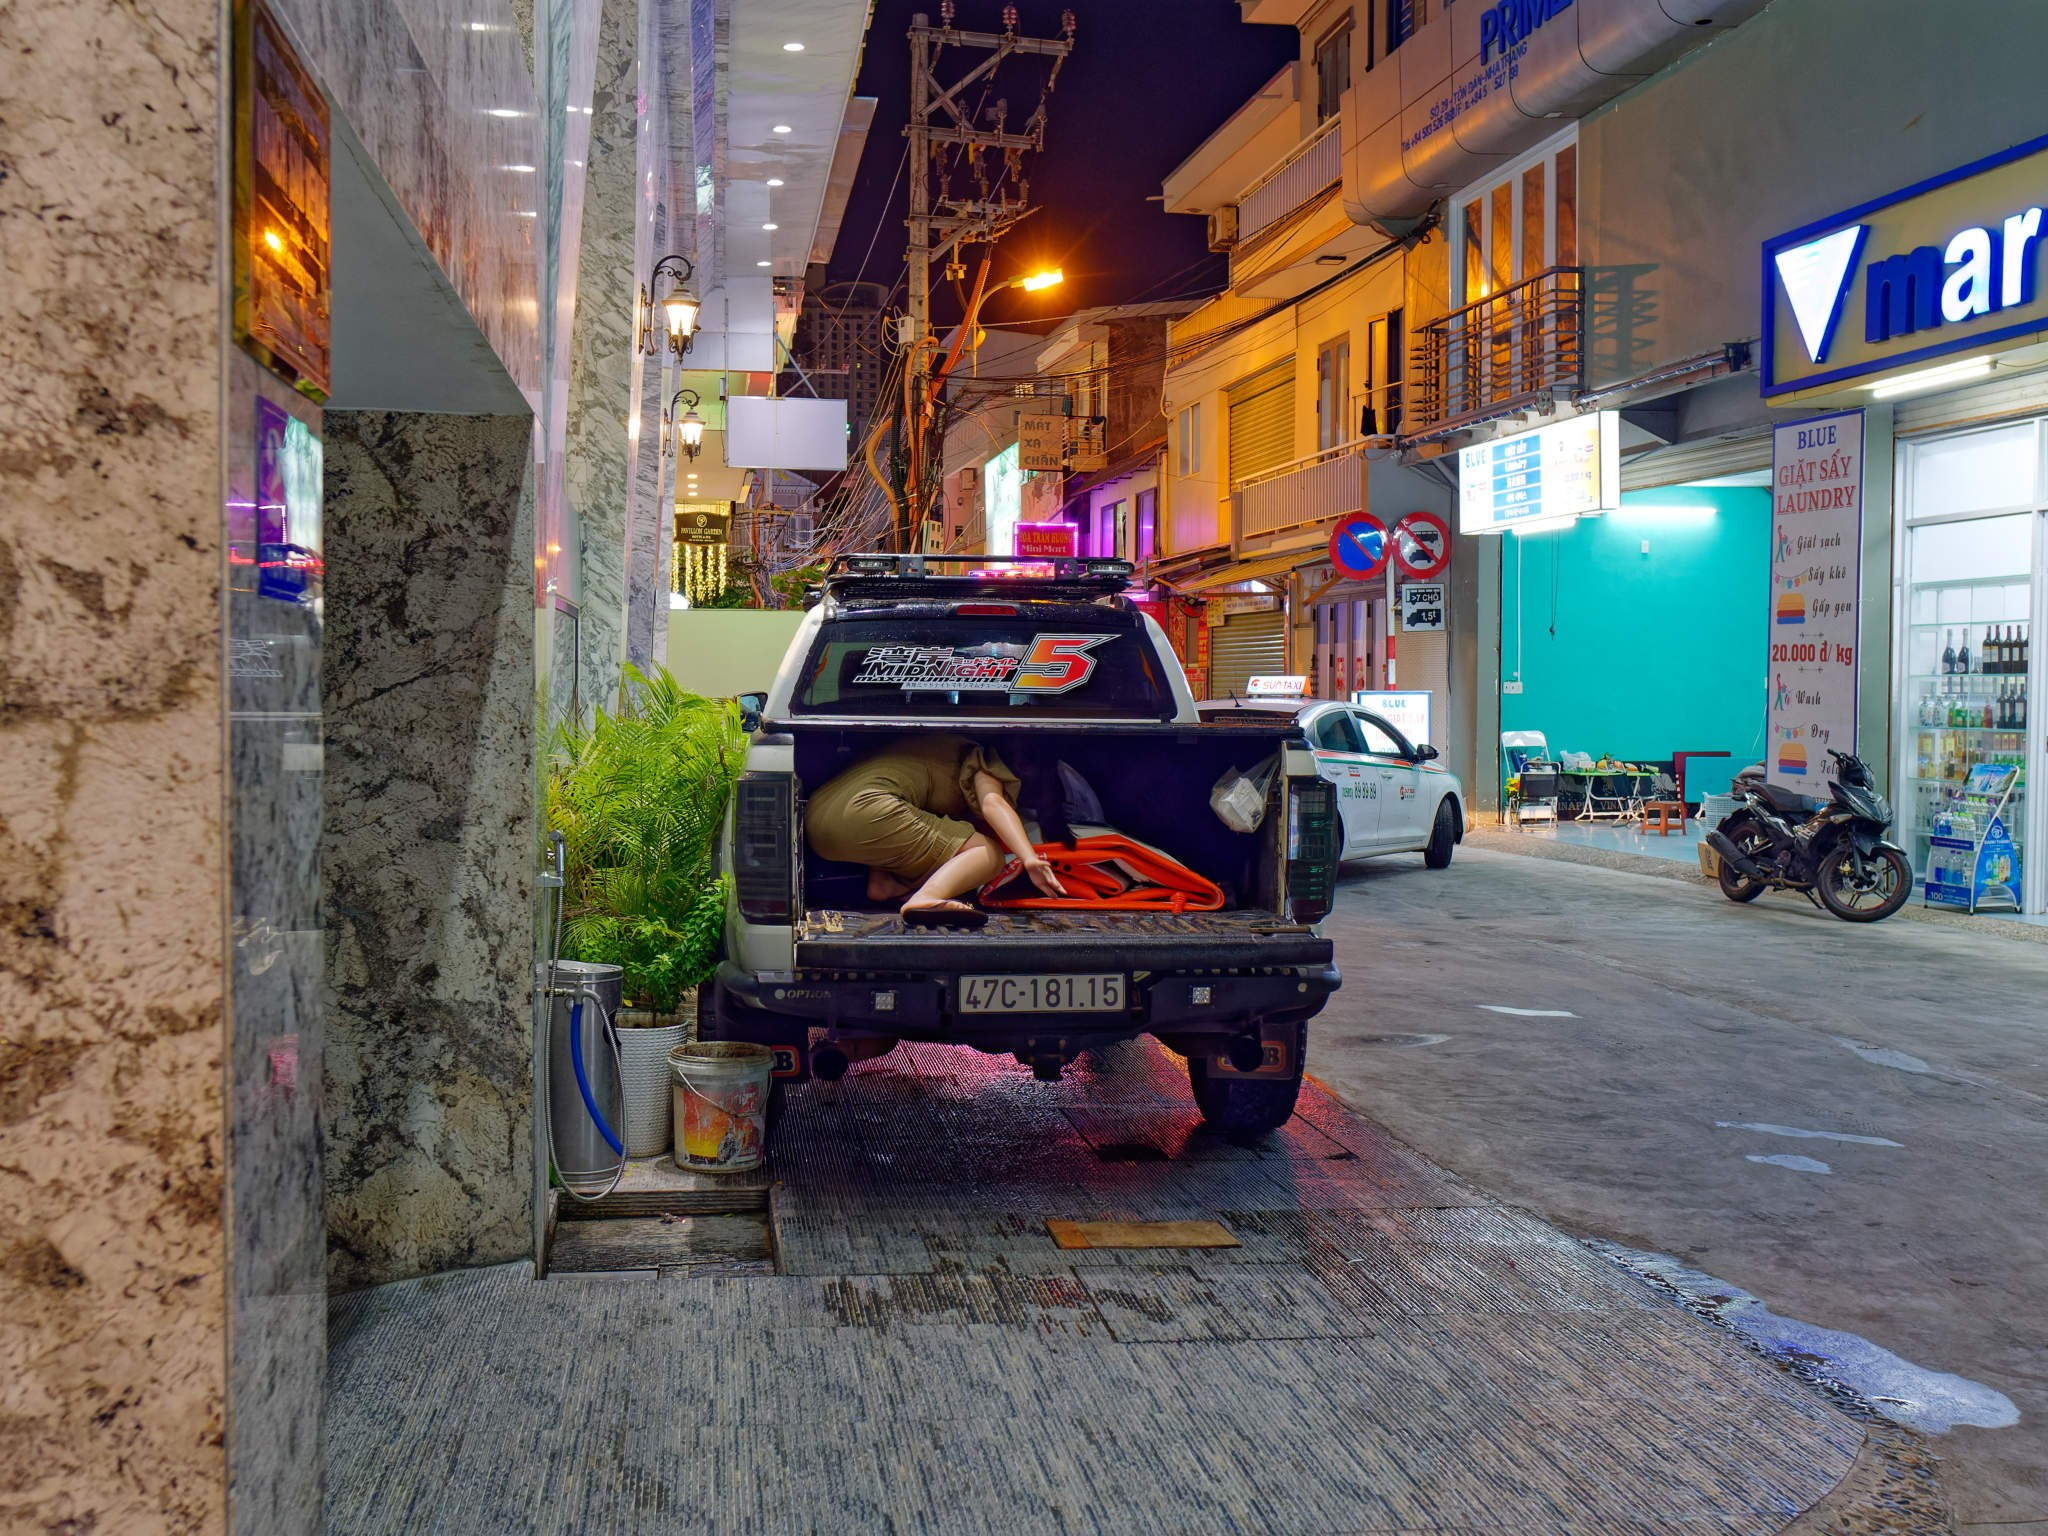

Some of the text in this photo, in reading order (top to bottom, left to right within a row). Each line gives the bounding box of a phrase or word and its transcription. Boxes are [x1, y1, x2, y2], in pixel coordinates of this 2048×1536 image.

[1797, 425, 1837, 450] BLUE
[1778, 448, 1852, 487] GIẶT SẤY
[1776, 485, 1857, 515] LAUNDRY
[1021, 544, 1067, 553] Mini Mart
[1772, 644, 1815, 662] 20.000
[1836, 643, 1853, 666] kg
[865, 657, 1020, 678] MIDNIGHT
[1283, 680, 1302, 690] TAXI
[1382, 699, 1407, 708] BLUE
[1795, 690, 1821, 705] Wash
[1810, 723, 1830, 744] Dry
[965, 977, 1119, 1009] 47C-181.15
